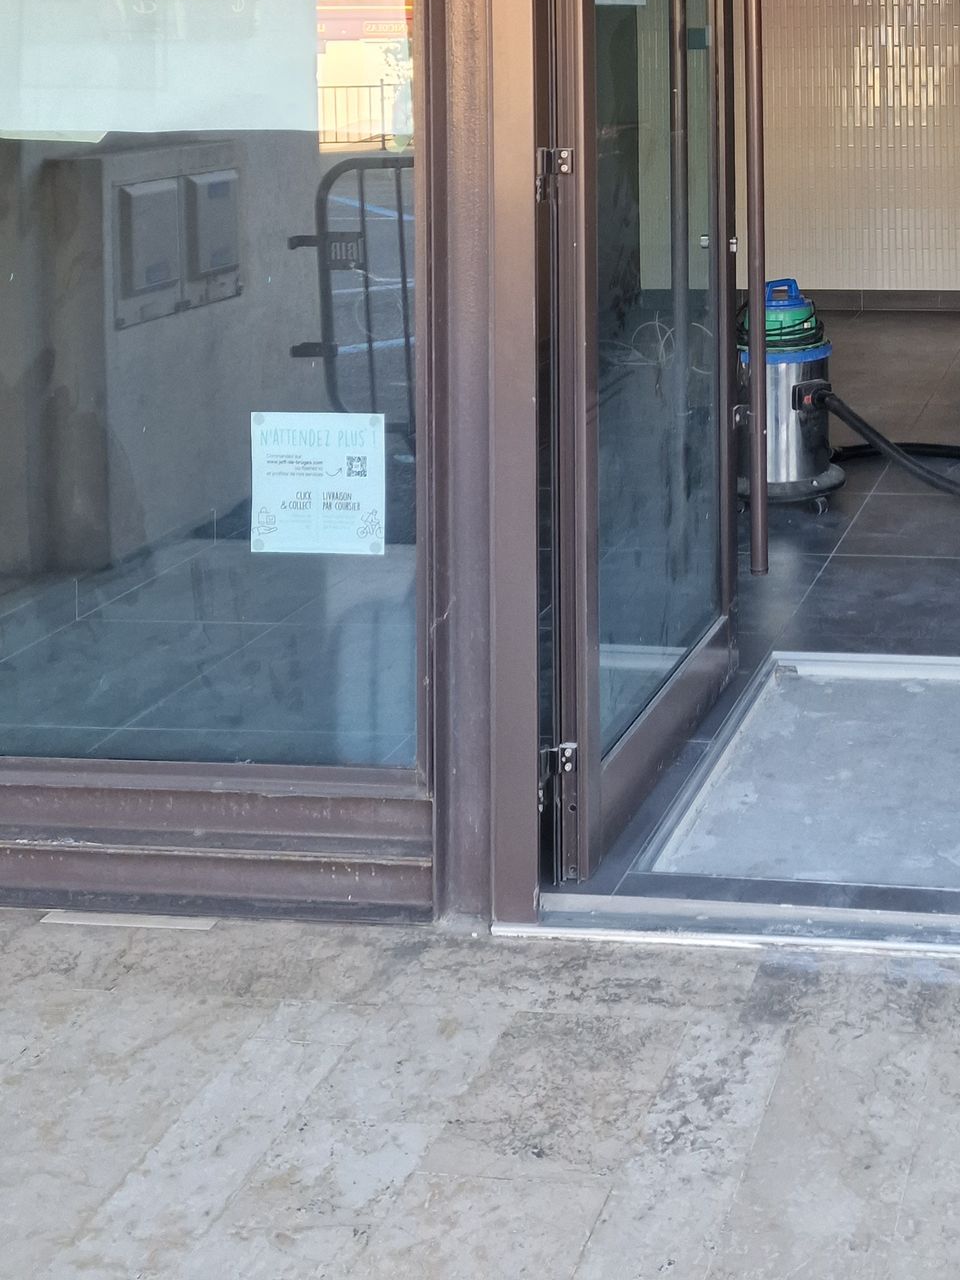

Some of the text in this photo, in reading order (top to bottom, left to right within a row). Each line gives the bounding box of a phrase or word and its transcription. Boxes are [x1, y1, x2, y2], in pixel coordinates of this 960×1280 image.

[260, 427, 330, 447] N'ATTENDEZ
[338, 429, 365, 448] PLUS
[296, 491, 312, 501] CLICK
[322, 491, 353, 501] LIVRAISON
[289, 501, 312, 510] COLLECT
[322, 501, 361, 511] PAR COURSIER
